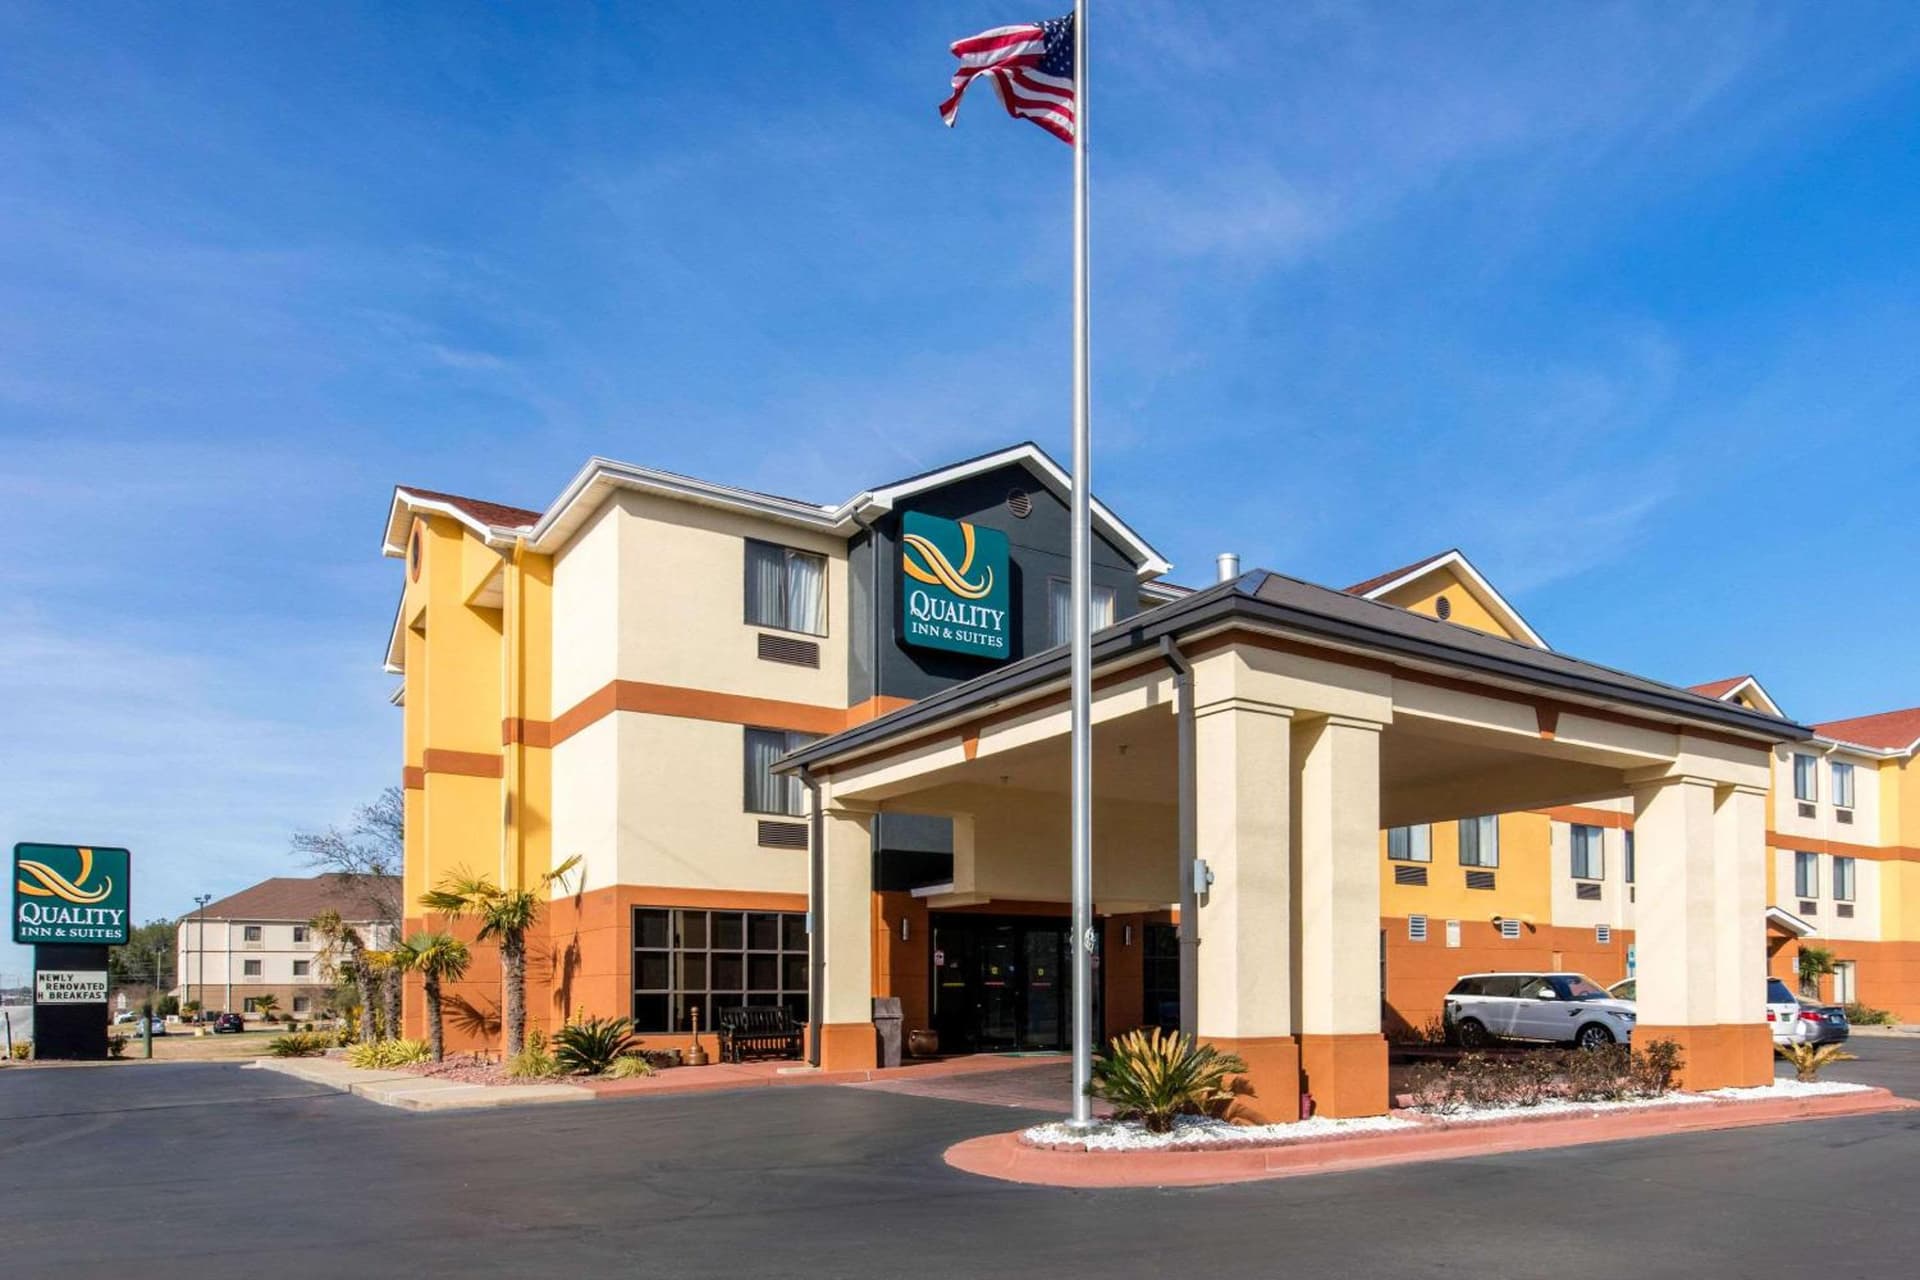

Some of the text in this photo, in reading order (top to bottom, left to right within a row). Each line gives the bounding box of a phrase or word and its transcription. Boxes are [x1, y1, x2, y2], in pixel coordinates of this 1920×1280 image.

[910, 590, 1005, 631] QUALITY
[912, 622, 1004, 648] INN & SUITES
[19, 902, 125, 926] QUALITY
[22, 927, 123, 938] INN & SUITES
[39, 974, 74, 982] NEWLY
[45, 982, 105, 991] RENOVATED
